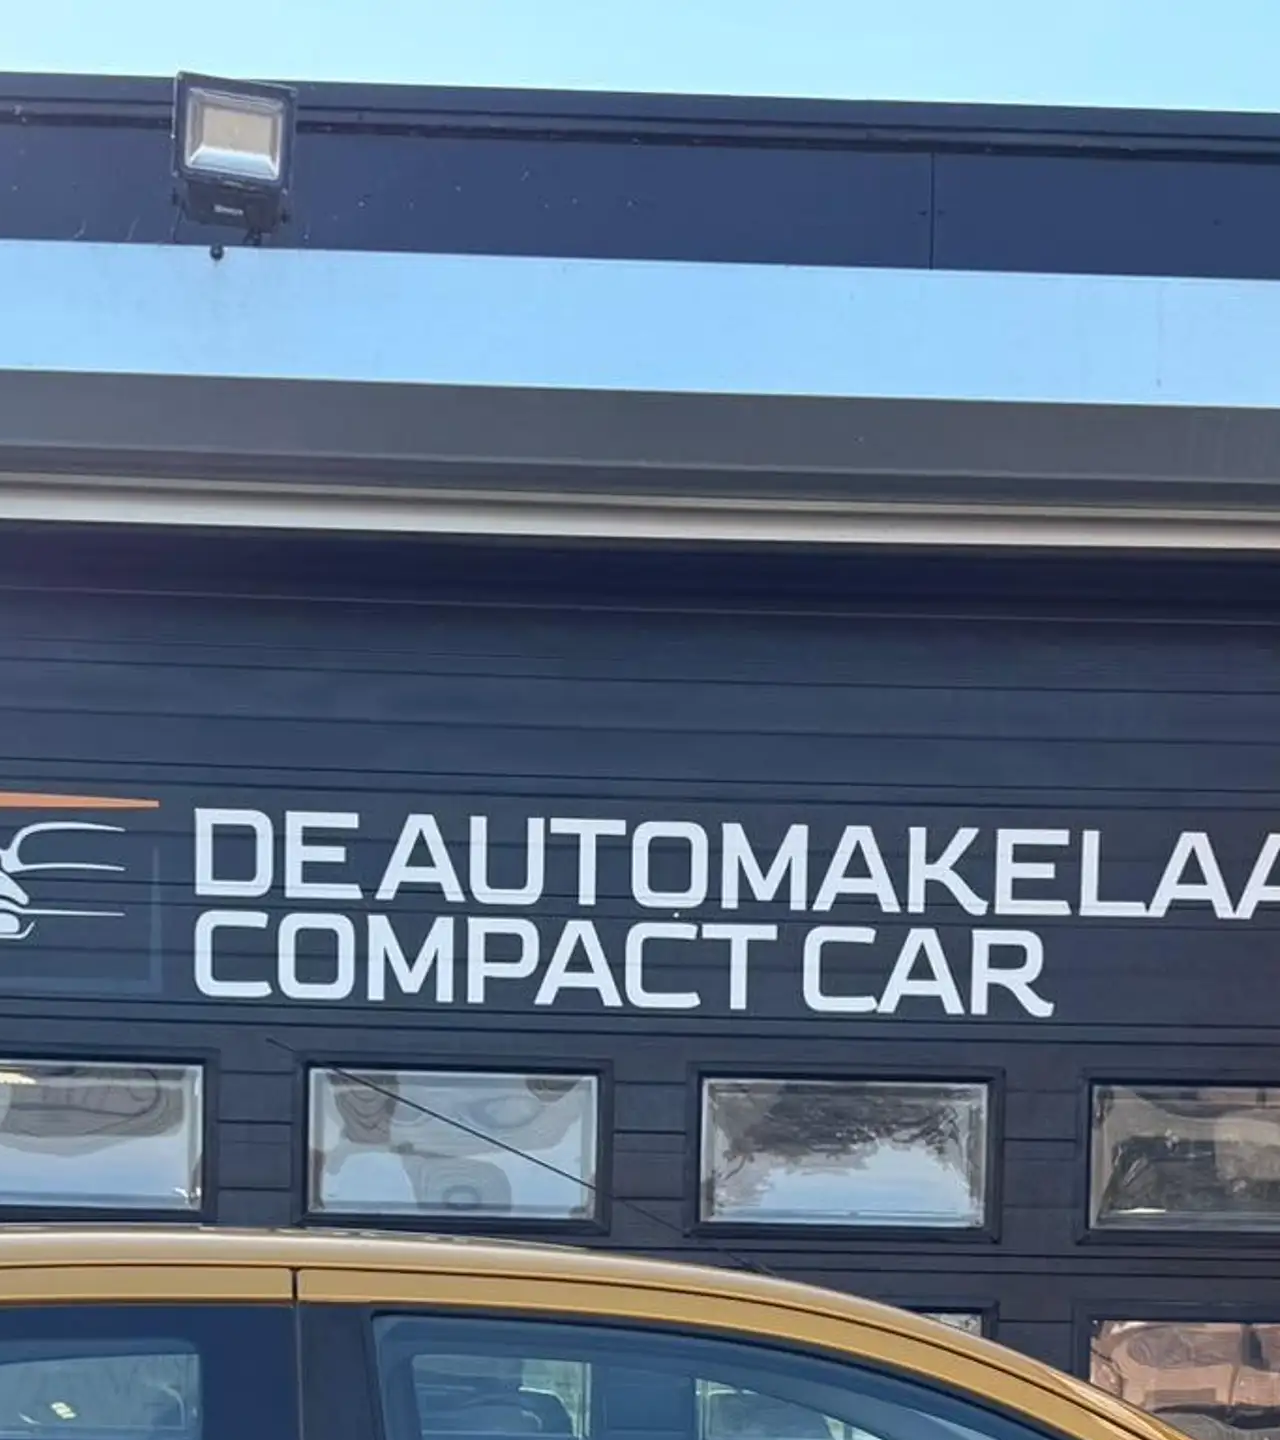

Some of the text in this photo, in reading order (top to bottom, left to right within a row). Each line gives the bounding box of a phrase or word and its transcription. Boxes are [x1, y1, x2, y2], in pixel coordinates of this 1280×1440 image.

[195, 807, 362, 900] DE
[195, 910, 1055, 1018] COMPACT CAR
